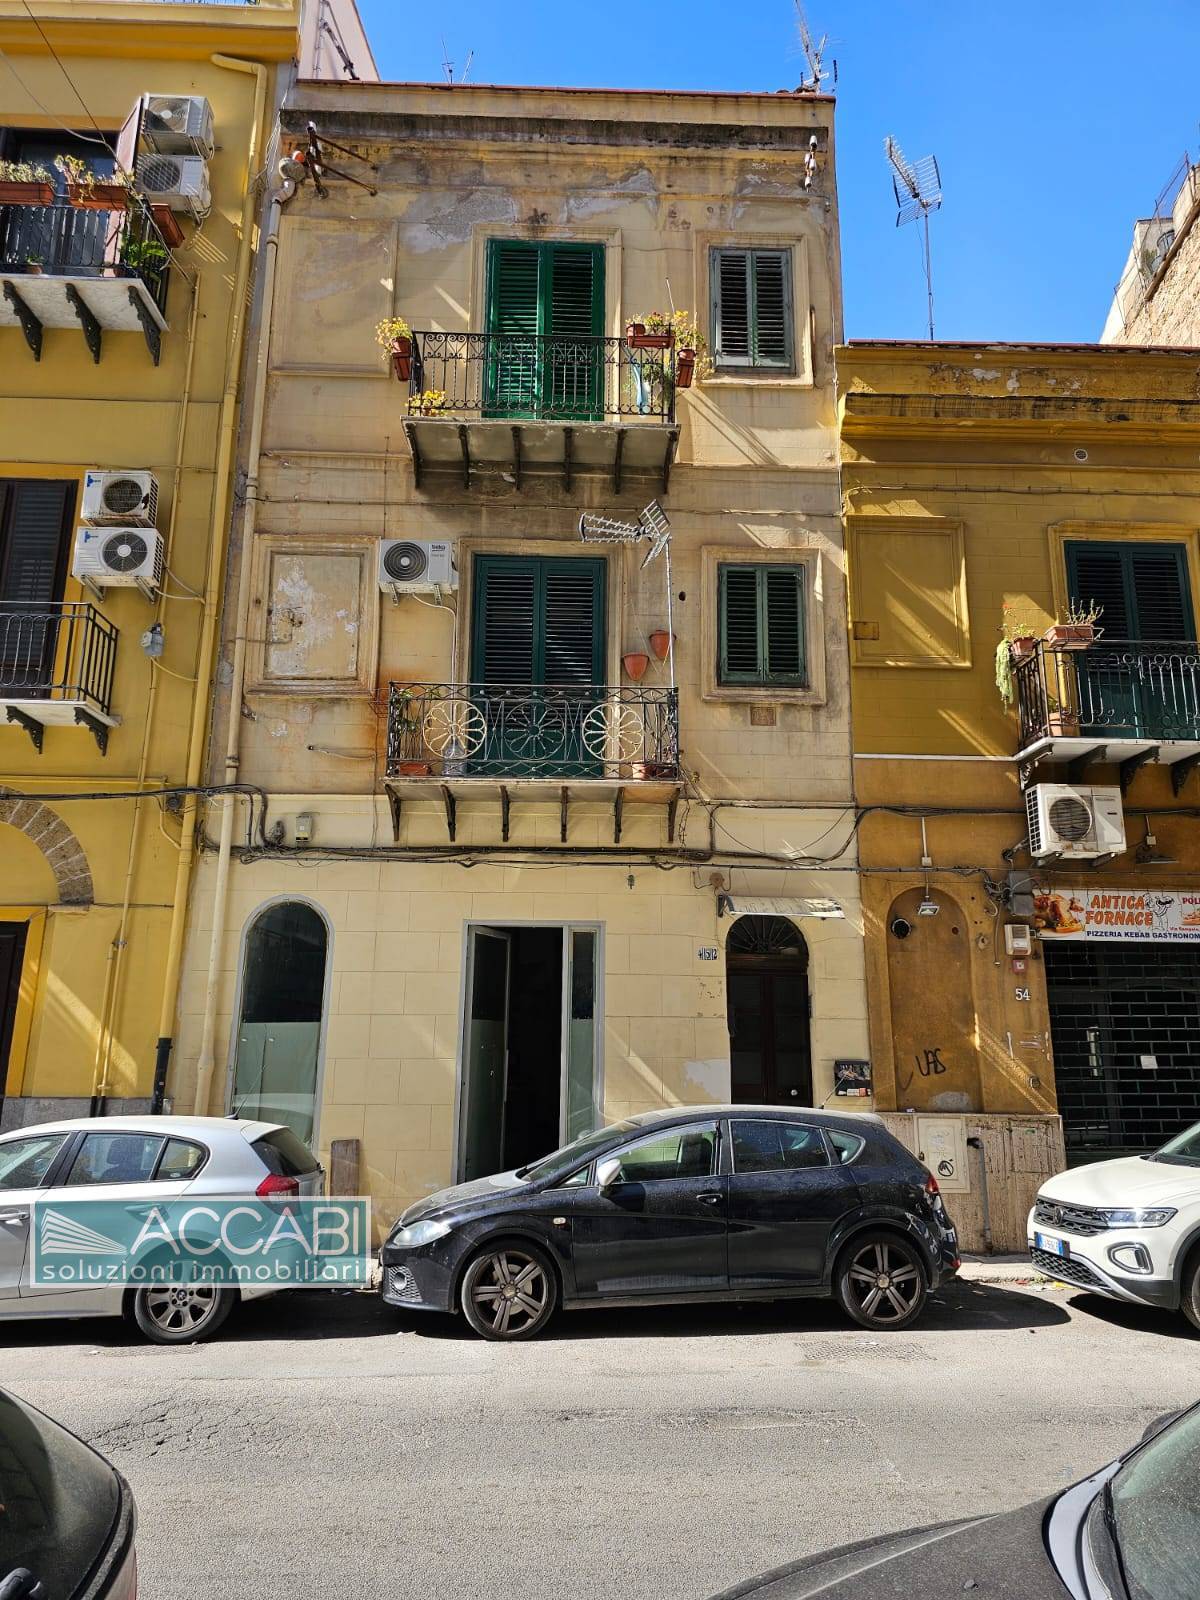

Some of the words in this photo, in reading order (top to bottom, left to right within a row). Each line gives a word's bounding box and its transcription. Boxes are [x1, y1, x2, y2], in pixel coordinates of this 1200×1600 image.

[1090, 894, 1145, 910] ANTICA
[1085, 911, 1154, 926] FORNACE
[1124, 931, 1150, 939] KEBAB
[1015, 988, 1031, 1001] 54
